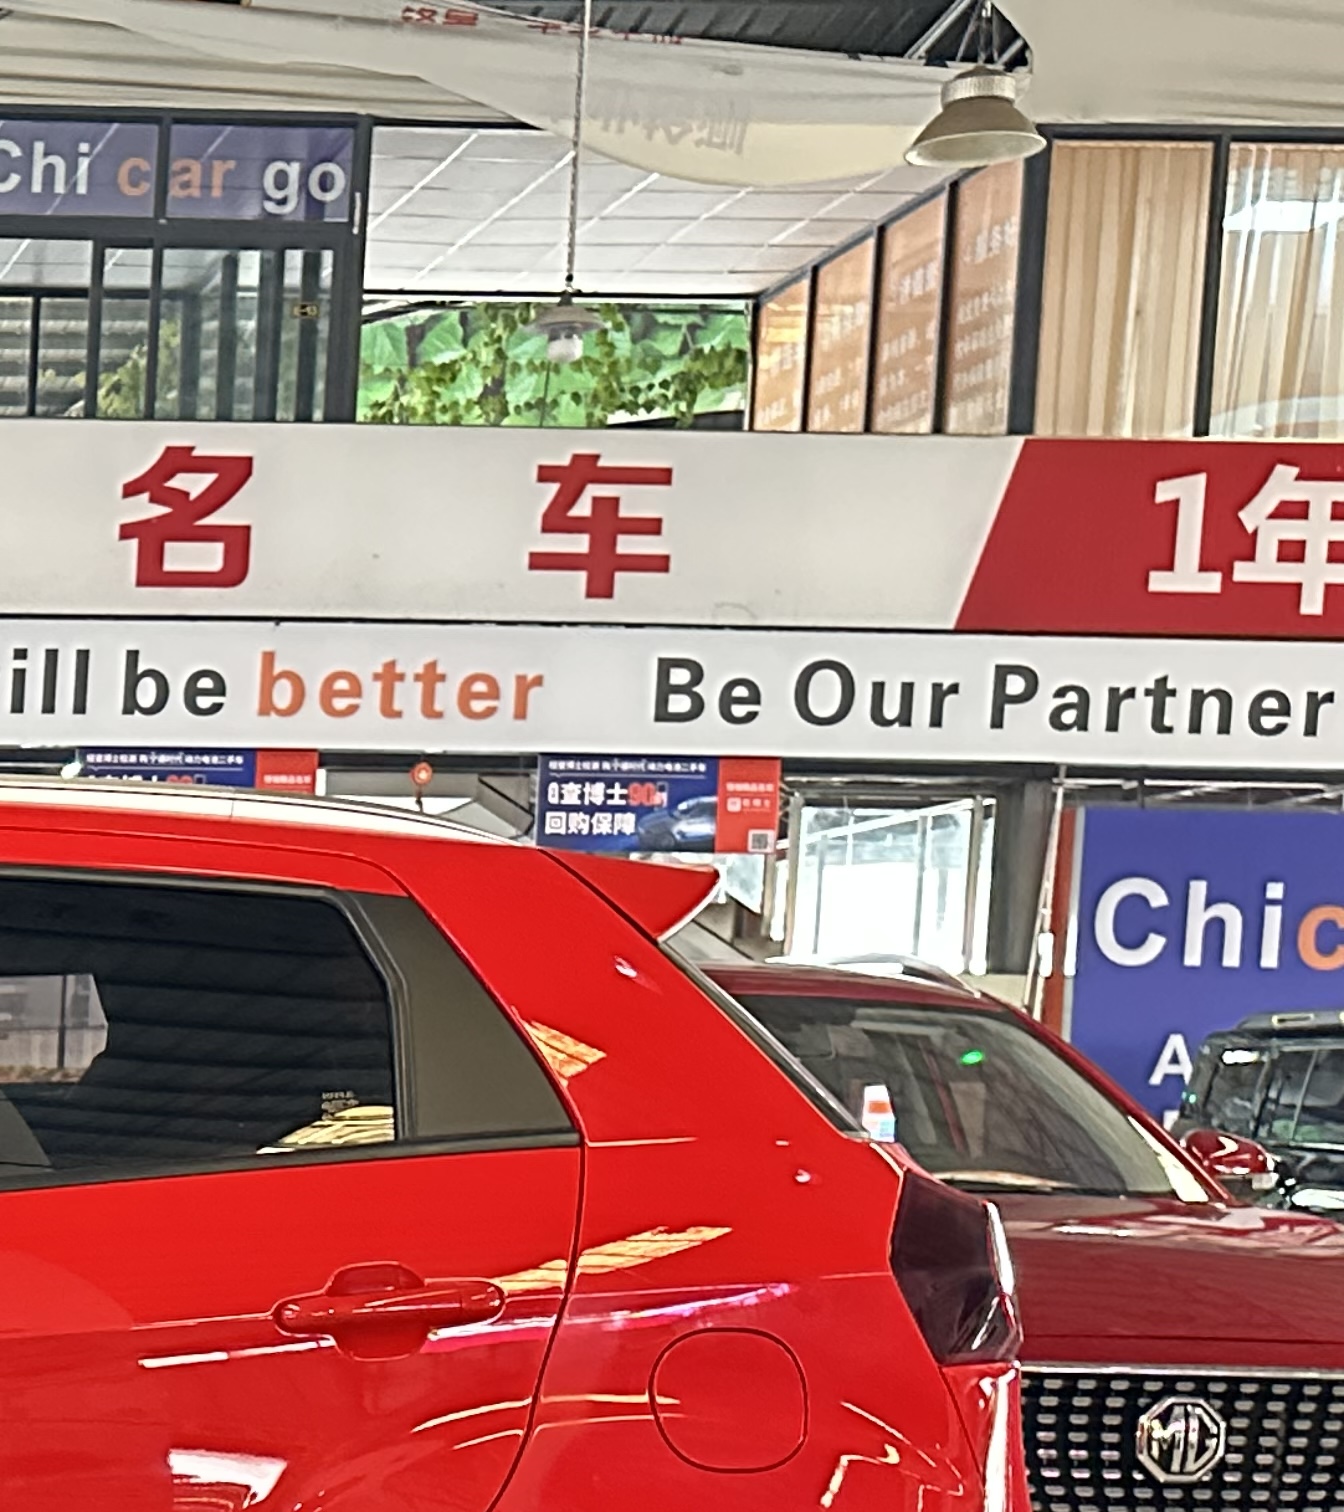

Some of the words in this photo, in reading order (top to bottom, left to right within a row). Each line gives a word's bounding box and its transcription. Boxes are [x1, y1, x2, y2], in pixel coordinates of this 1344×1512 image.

[117, 156, 237, 199] car
[262, 161, 347, 214] go
[121, 649, 228, 718] be
[257, 651, 545, 721] better
[654, 656, 764, 726] Be
[793, 658, 961, 730] Our
[989, 664, 1336, 738] Partner
[544, 811, 637, 836] 回购保障
